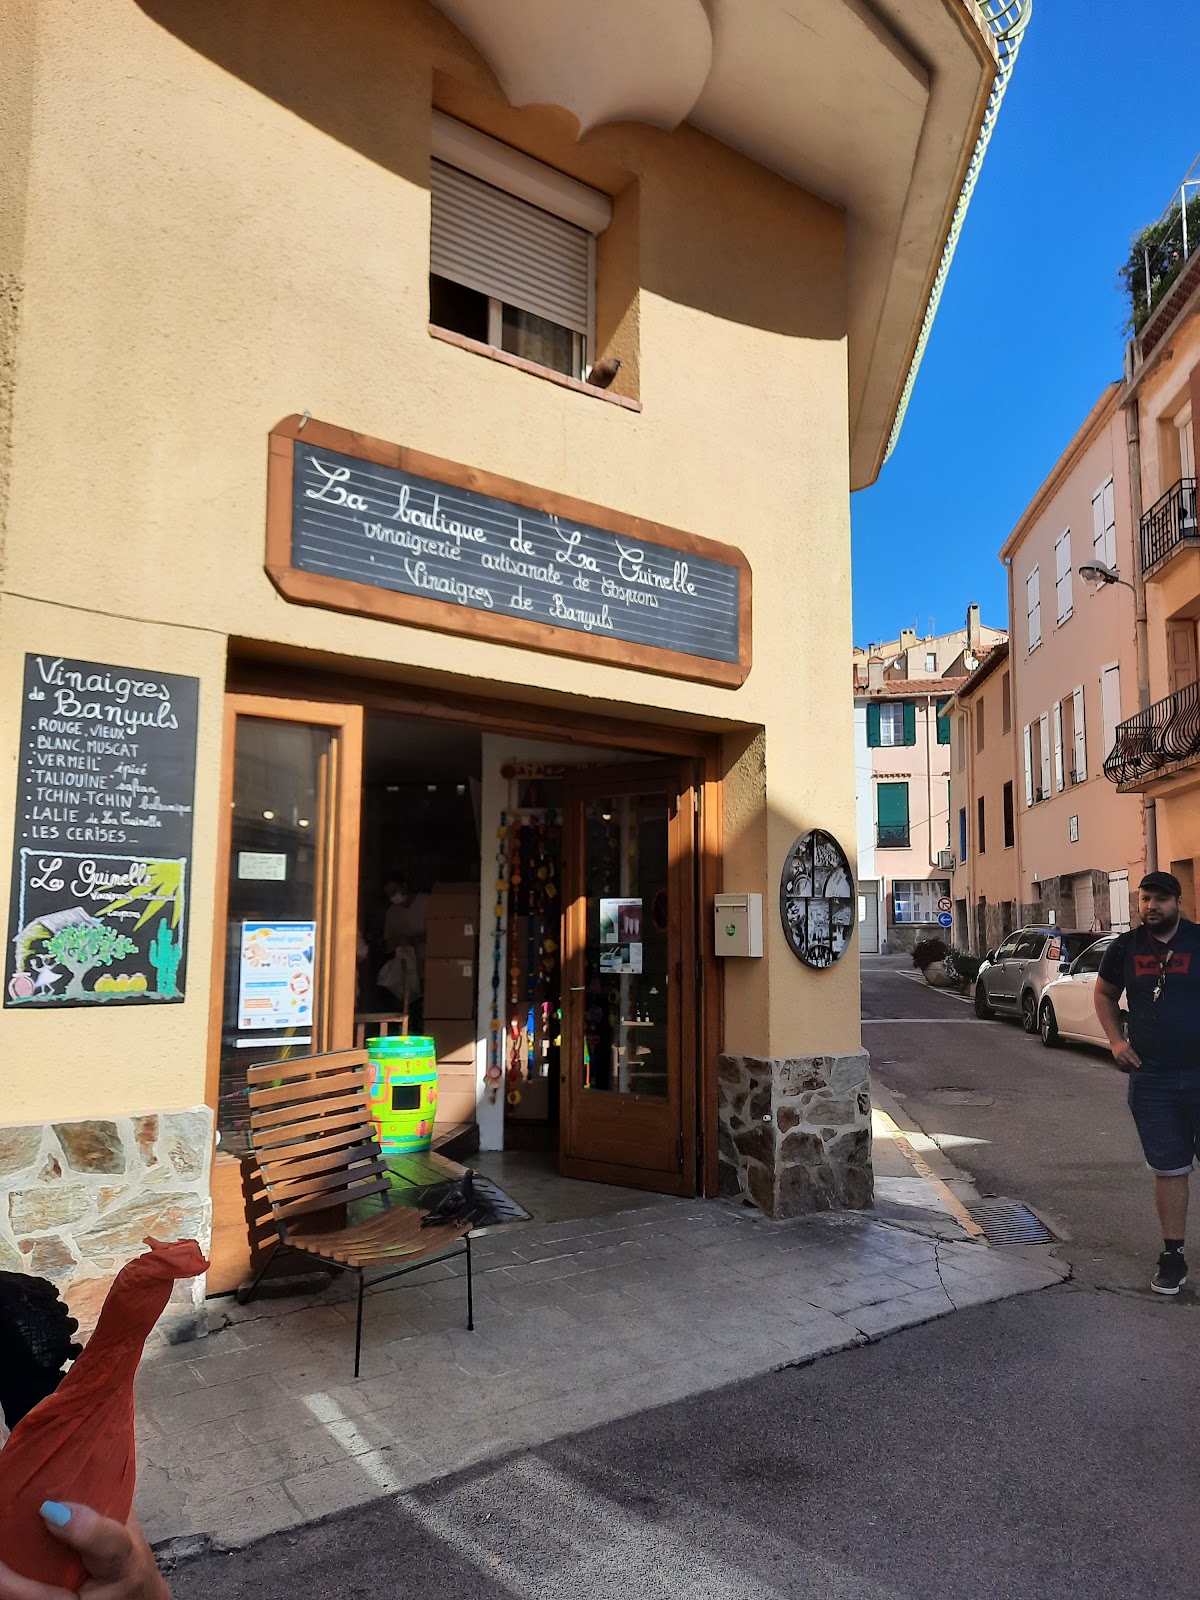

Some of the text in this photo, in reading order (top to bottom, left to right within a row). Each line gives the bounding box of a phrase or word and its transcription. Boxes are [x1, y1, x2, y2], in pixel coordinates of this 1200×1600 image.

[305, 455, 368, 511] La
[390, 485, 487, 546] boutique
[510, 518, 535, 555] de
[615, 540, 698, 596] Guinelle
[363, 522, 659, 608] vinaigrerie artisanale de Cosprons
[404, 557, 613, 630] Vinaigres de Banyuls
[35, 657, 170, 703] Vinaigres
[28, 686, 179, 735] de Banyuls
[87, 740, 140, 758] MUSCAT
[89, 724, 126, 740] VIEUX
[33, 806, 80, 823] LALIE
[36, 787, 133, 809] TCHIN-TCHIN
[32, 826, 60, 839] LES
[70, 860, 154, 897] Guinelle
